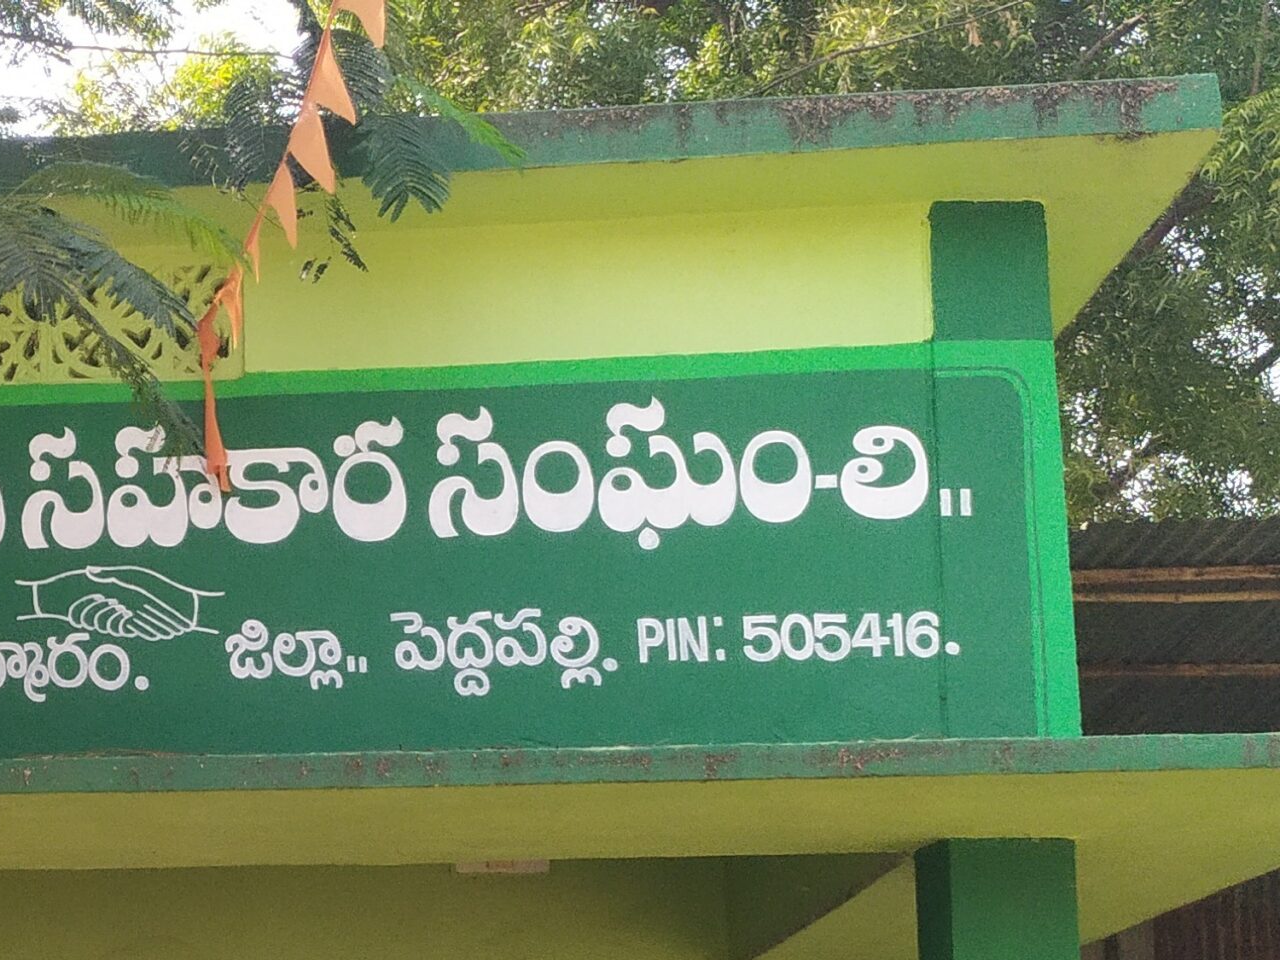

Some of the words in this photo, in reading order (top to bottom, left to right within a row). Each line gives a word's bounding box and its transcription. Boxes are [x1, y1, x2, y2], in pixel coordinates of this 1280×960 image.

[21, 416, 408, 550] సహకార
[389, 608, 620, 698] పెద్దపల్లి.
[636, 616, 727, 665] PIN:
[742, 611, 962, 664] 505416.
